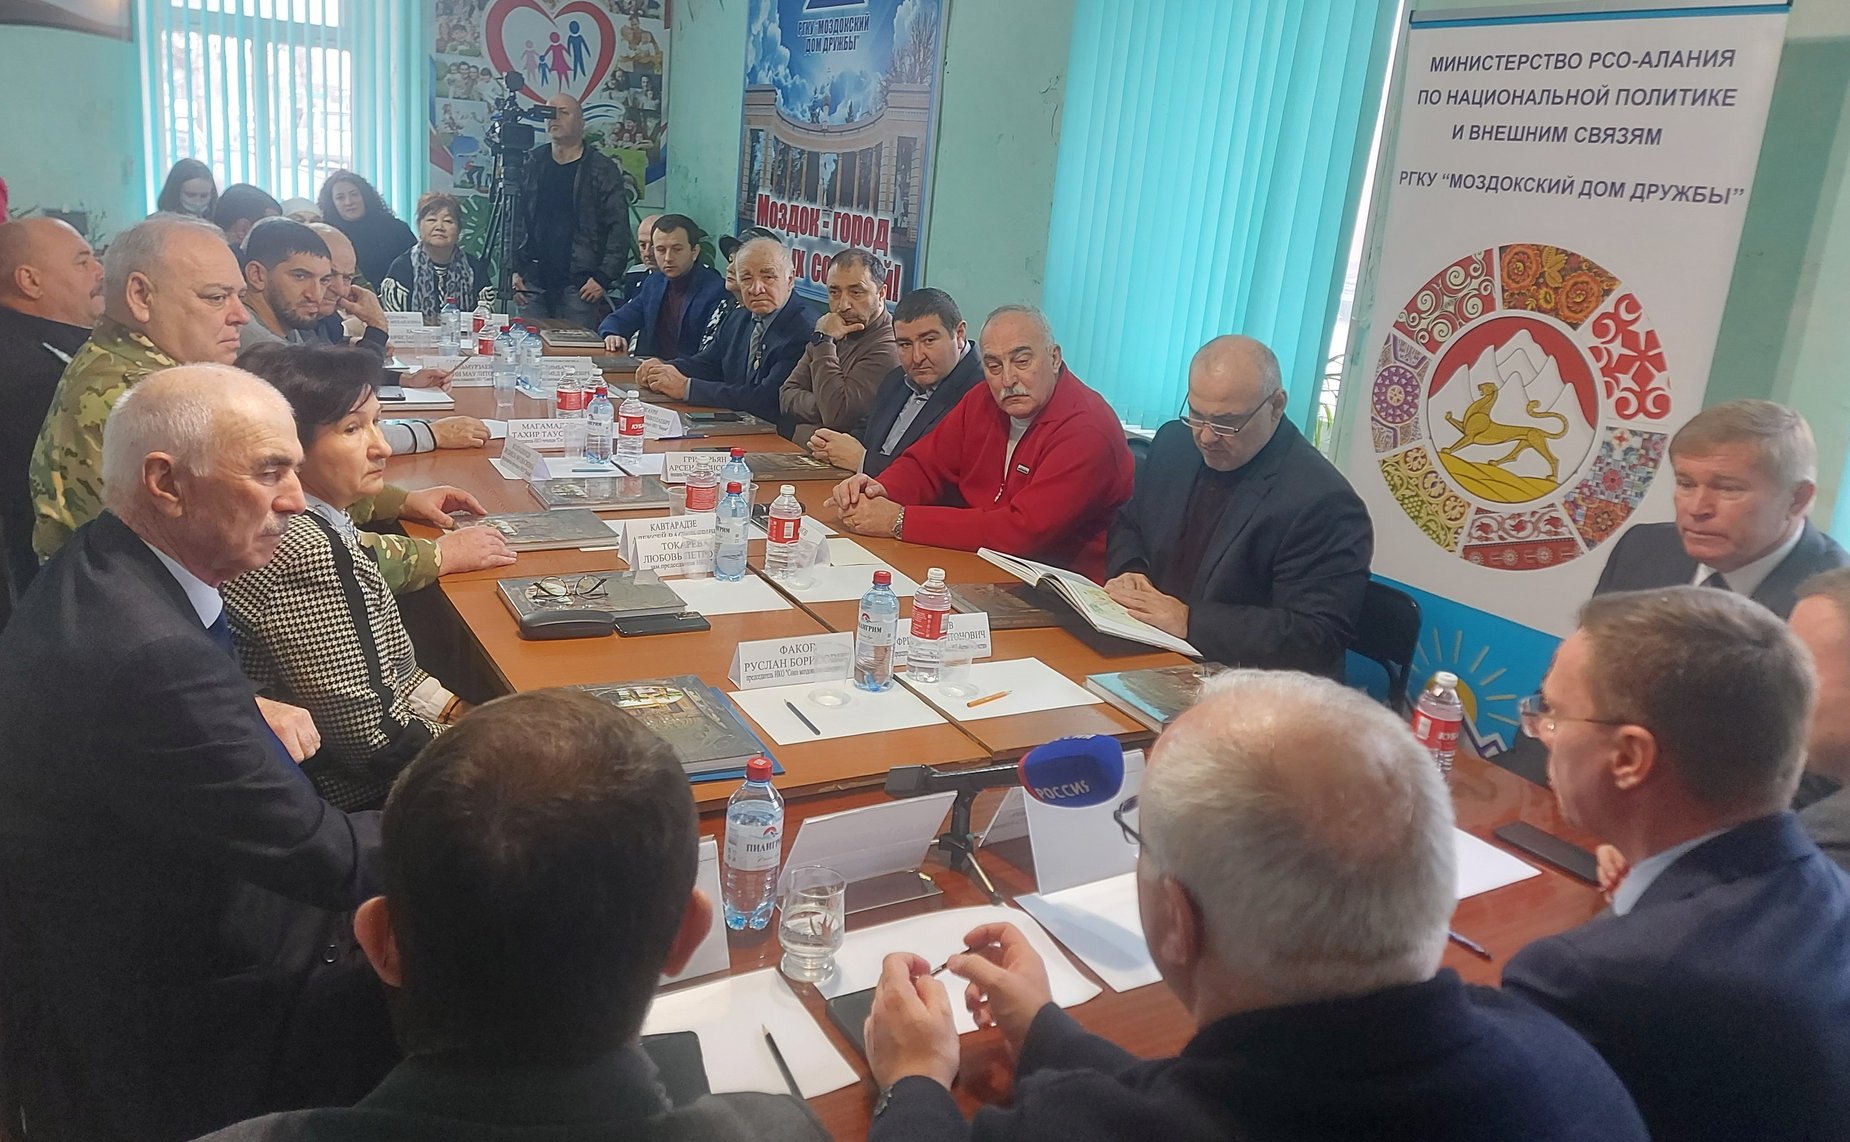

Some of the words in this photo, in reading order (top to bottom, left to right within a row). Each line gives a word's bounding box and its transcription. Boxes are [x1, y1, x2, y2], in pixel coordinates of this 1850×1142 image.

[805, 37, 822, 53] ДОМ
[1430, 52, 1582, 72] МИНИСТЕРСТВО
[1588, 49, 1736, 69] РСО-АЛАНИЯ
[1417, 89, 1442, 105] ПО
[1446, 84, 1610, 108] НАЦИОНАЛЬНОЙ
[1615, 88, 1738, 106] ПОЛИТИКЕ
[1452, 124, 1465, 140] И
[1469, 125, 1568, 143] ВНЕШНИМ
[1574, 126, 1663, 145] СВЯЗЯМ
[1399, 171, 1438, 187] РГКУ
[1578, 180, 1626, 199] ДОМ
[756, 193, 821, 238] Моздок
[832, 211, 890, 256] город
[512, 431, 540, 439] ТАХИР
[542, 430, 564, 438] ТАУС
[650, 519, 697, 532] КАВТАРАДЗЕ
[643, 552, 683, 564] ЛЮБОВЬ
[744, 658, 787, 673] РУСЛАН
